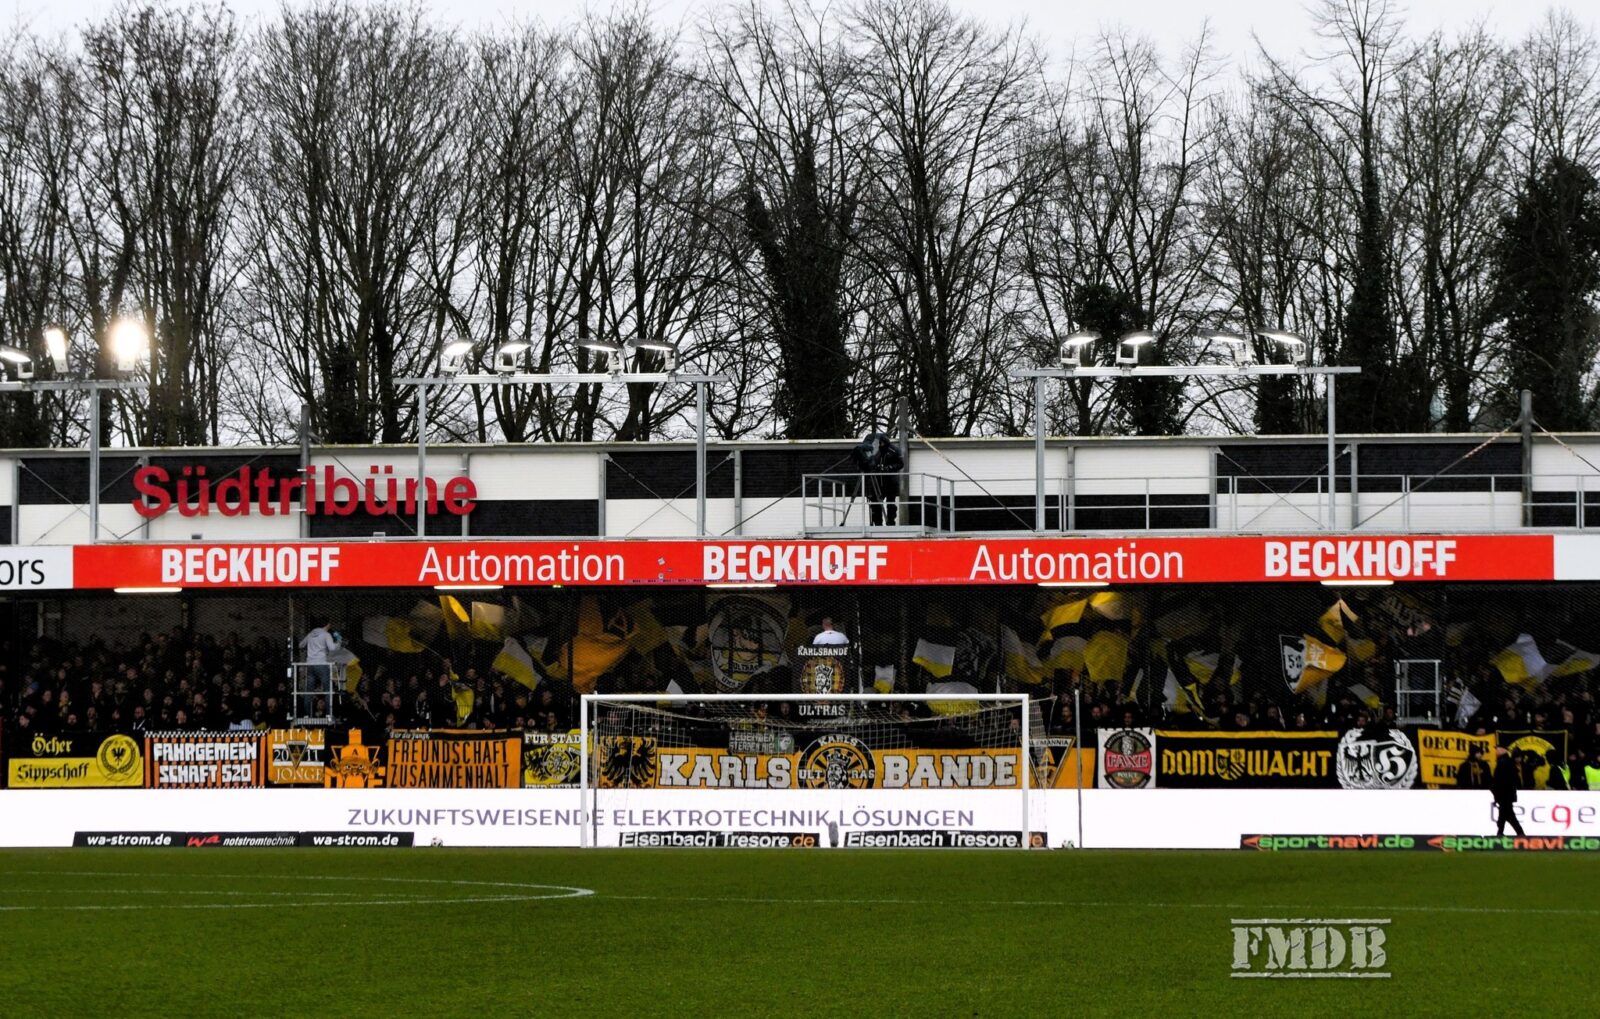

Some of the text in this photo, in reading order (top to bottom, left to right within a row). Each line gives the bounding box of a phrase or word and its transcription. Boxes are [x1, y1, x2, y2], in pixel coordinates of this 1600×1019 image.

[132, 465, 477, 517] Südtribüne
[161, 547, 340, 583] BECKHOFF
[418, 545, 625, 583] Automation
[703, 545, 888, 582] BECKHOFF
[969, 544, 1184, 581] Automation
[1265, 540, 1457, 577] BECKHOFF
[798, 704, 846, 717] ULTRAS
[31, 732, 73, 757] Öcher
[525, 730, 589, 744] FÜR STAD
[817, 735, 859, 746] KARLS
[274, 749, 289, 764] 20
[392, 740, 508, 764] FREUNDSCHAFT
[1162, 749, 1332, 776] DOM WACHT
[159, 764, 251, 783] SCHAFT 520
[390, 764, 510, 788] ZUSAMMENHALT
[659, 755, 791, 789] KARLS
[882, 755, 1017, 788] BANDE
[348, 805, 974, 827] ZUKUNFTSWEISENDE ELEKTROTECHNIK LÖSUNGEN
[87, 834, 172, 846] wa-strom.de
[313, 834, 399, 847] wa-strom.de
[622, 832, 717, 848] Eisenbach
[847, 832, 943, 848] Eisenbach
[1259, 834, 1415, 850] sportnavi.de
[1443, 836, 1600, 850] sportnavi.de
